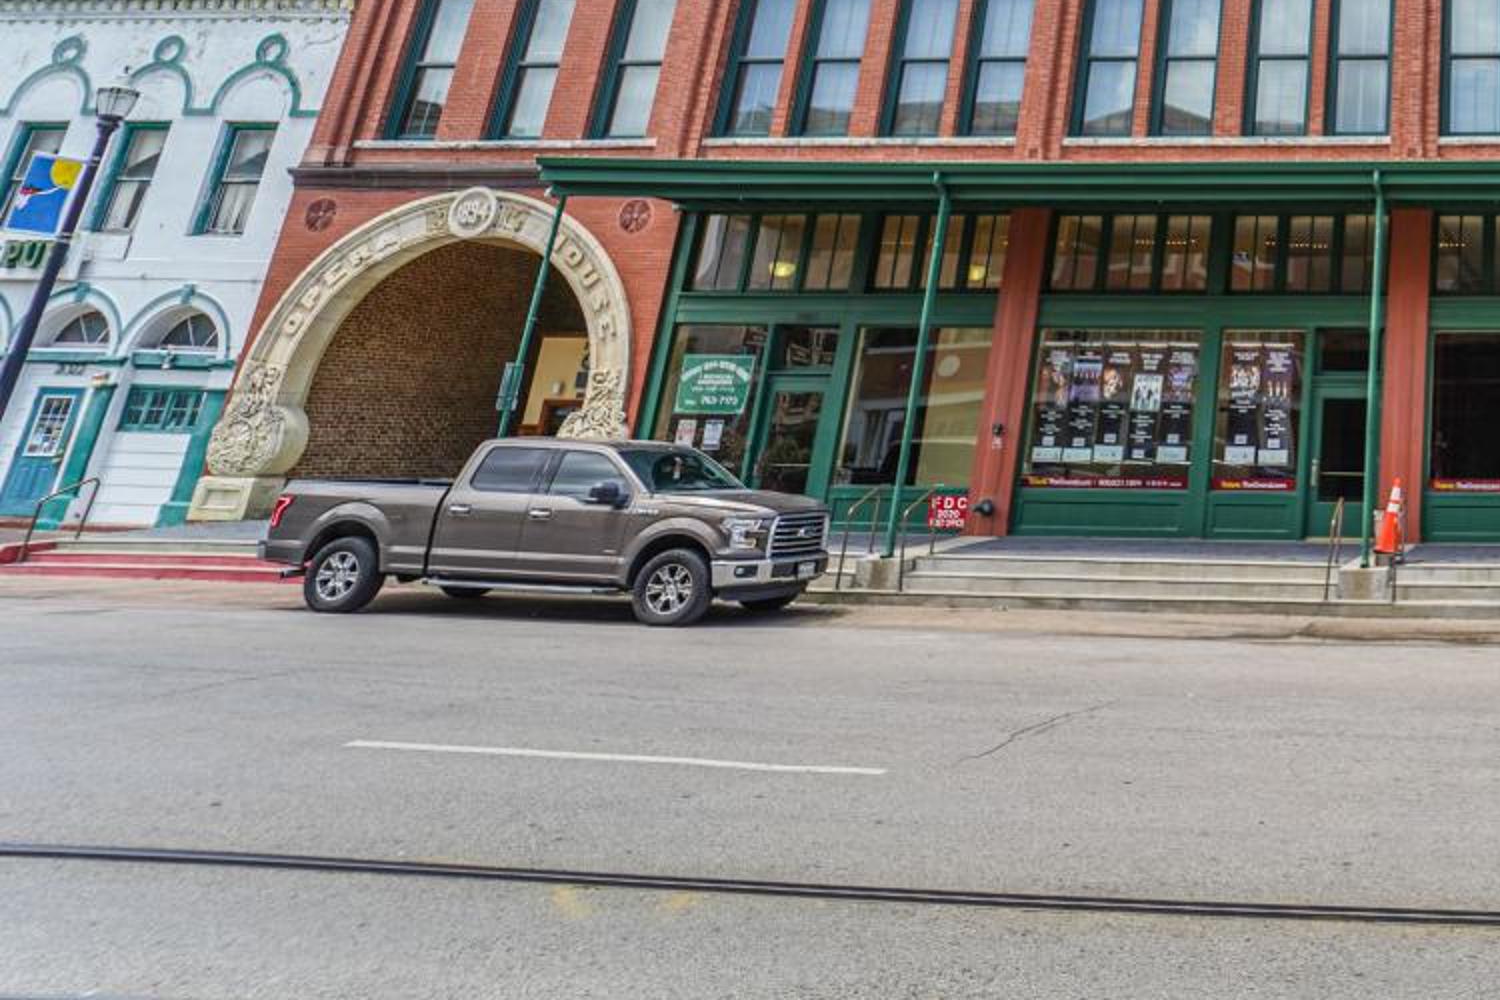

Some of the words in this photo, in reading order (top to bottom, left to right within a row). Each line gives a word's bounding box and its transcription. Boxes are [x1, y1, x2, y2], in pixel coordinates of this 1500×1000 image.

[457, 200, 491, 224] 1894
[2, 241, 53, 268] PU
[284, 234, 398, 335] OPERA
